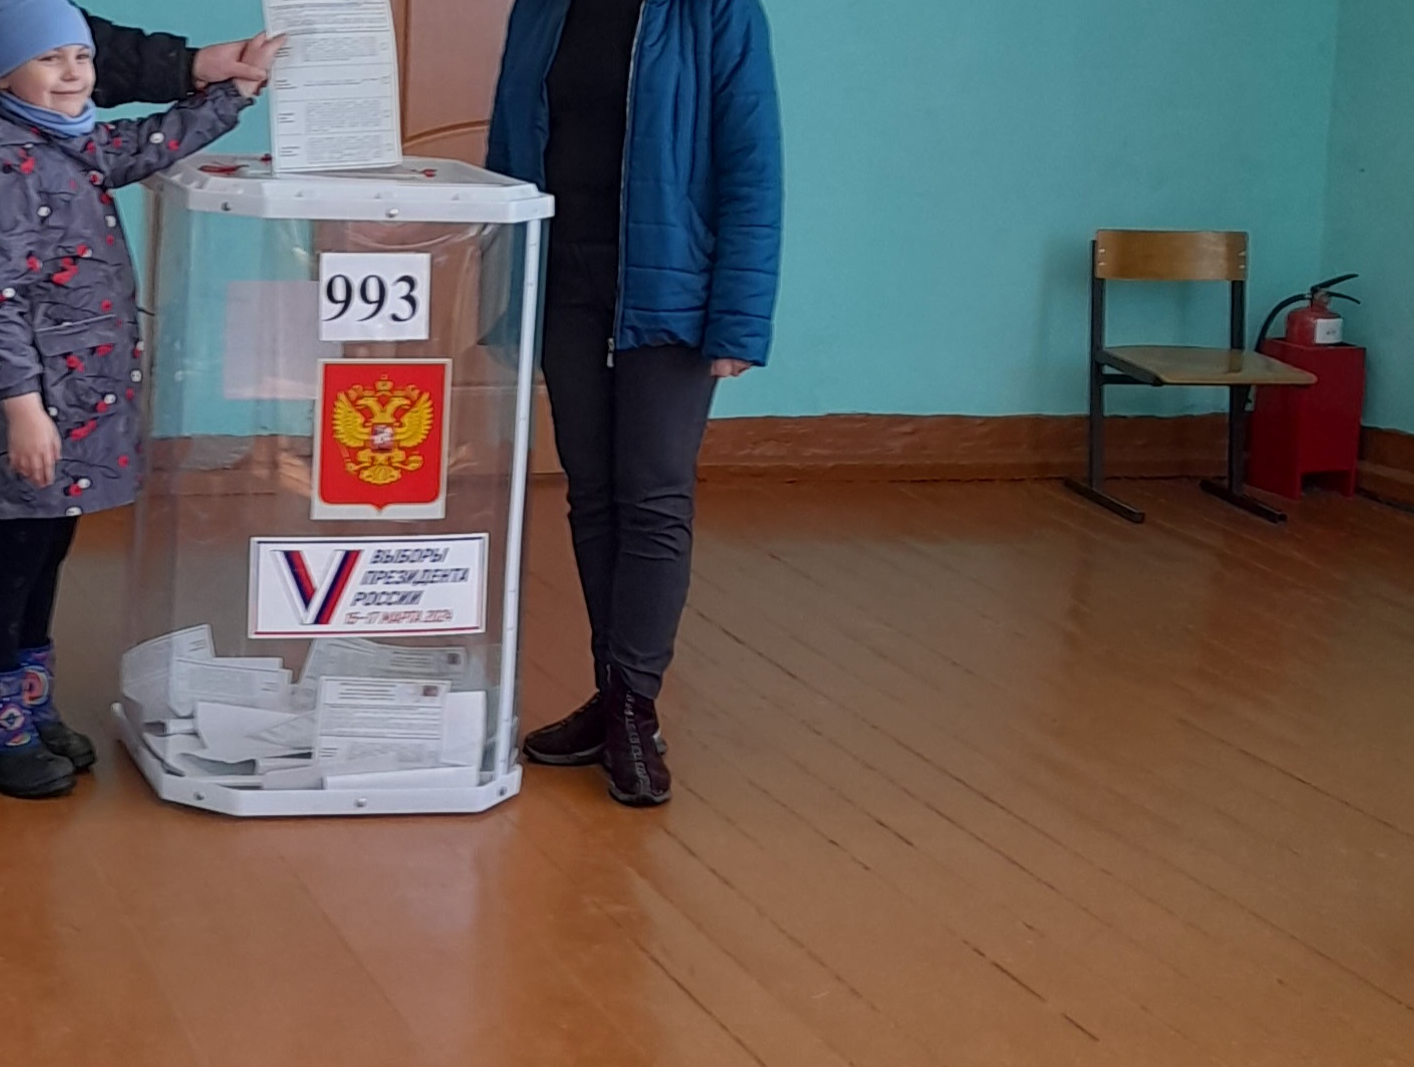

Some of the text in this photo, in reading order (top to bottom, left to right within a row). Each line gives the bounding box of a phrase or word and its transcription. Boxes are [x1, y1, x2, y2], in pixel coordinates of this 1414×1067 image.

[321, 274, 418, 323] 993
[369, 547, 450, 564] ВЫБОРЫ
[359, 567, 471, 586] ПРЕЗИДЕНТА
[349, 590, 425, 607] РОССИИ
